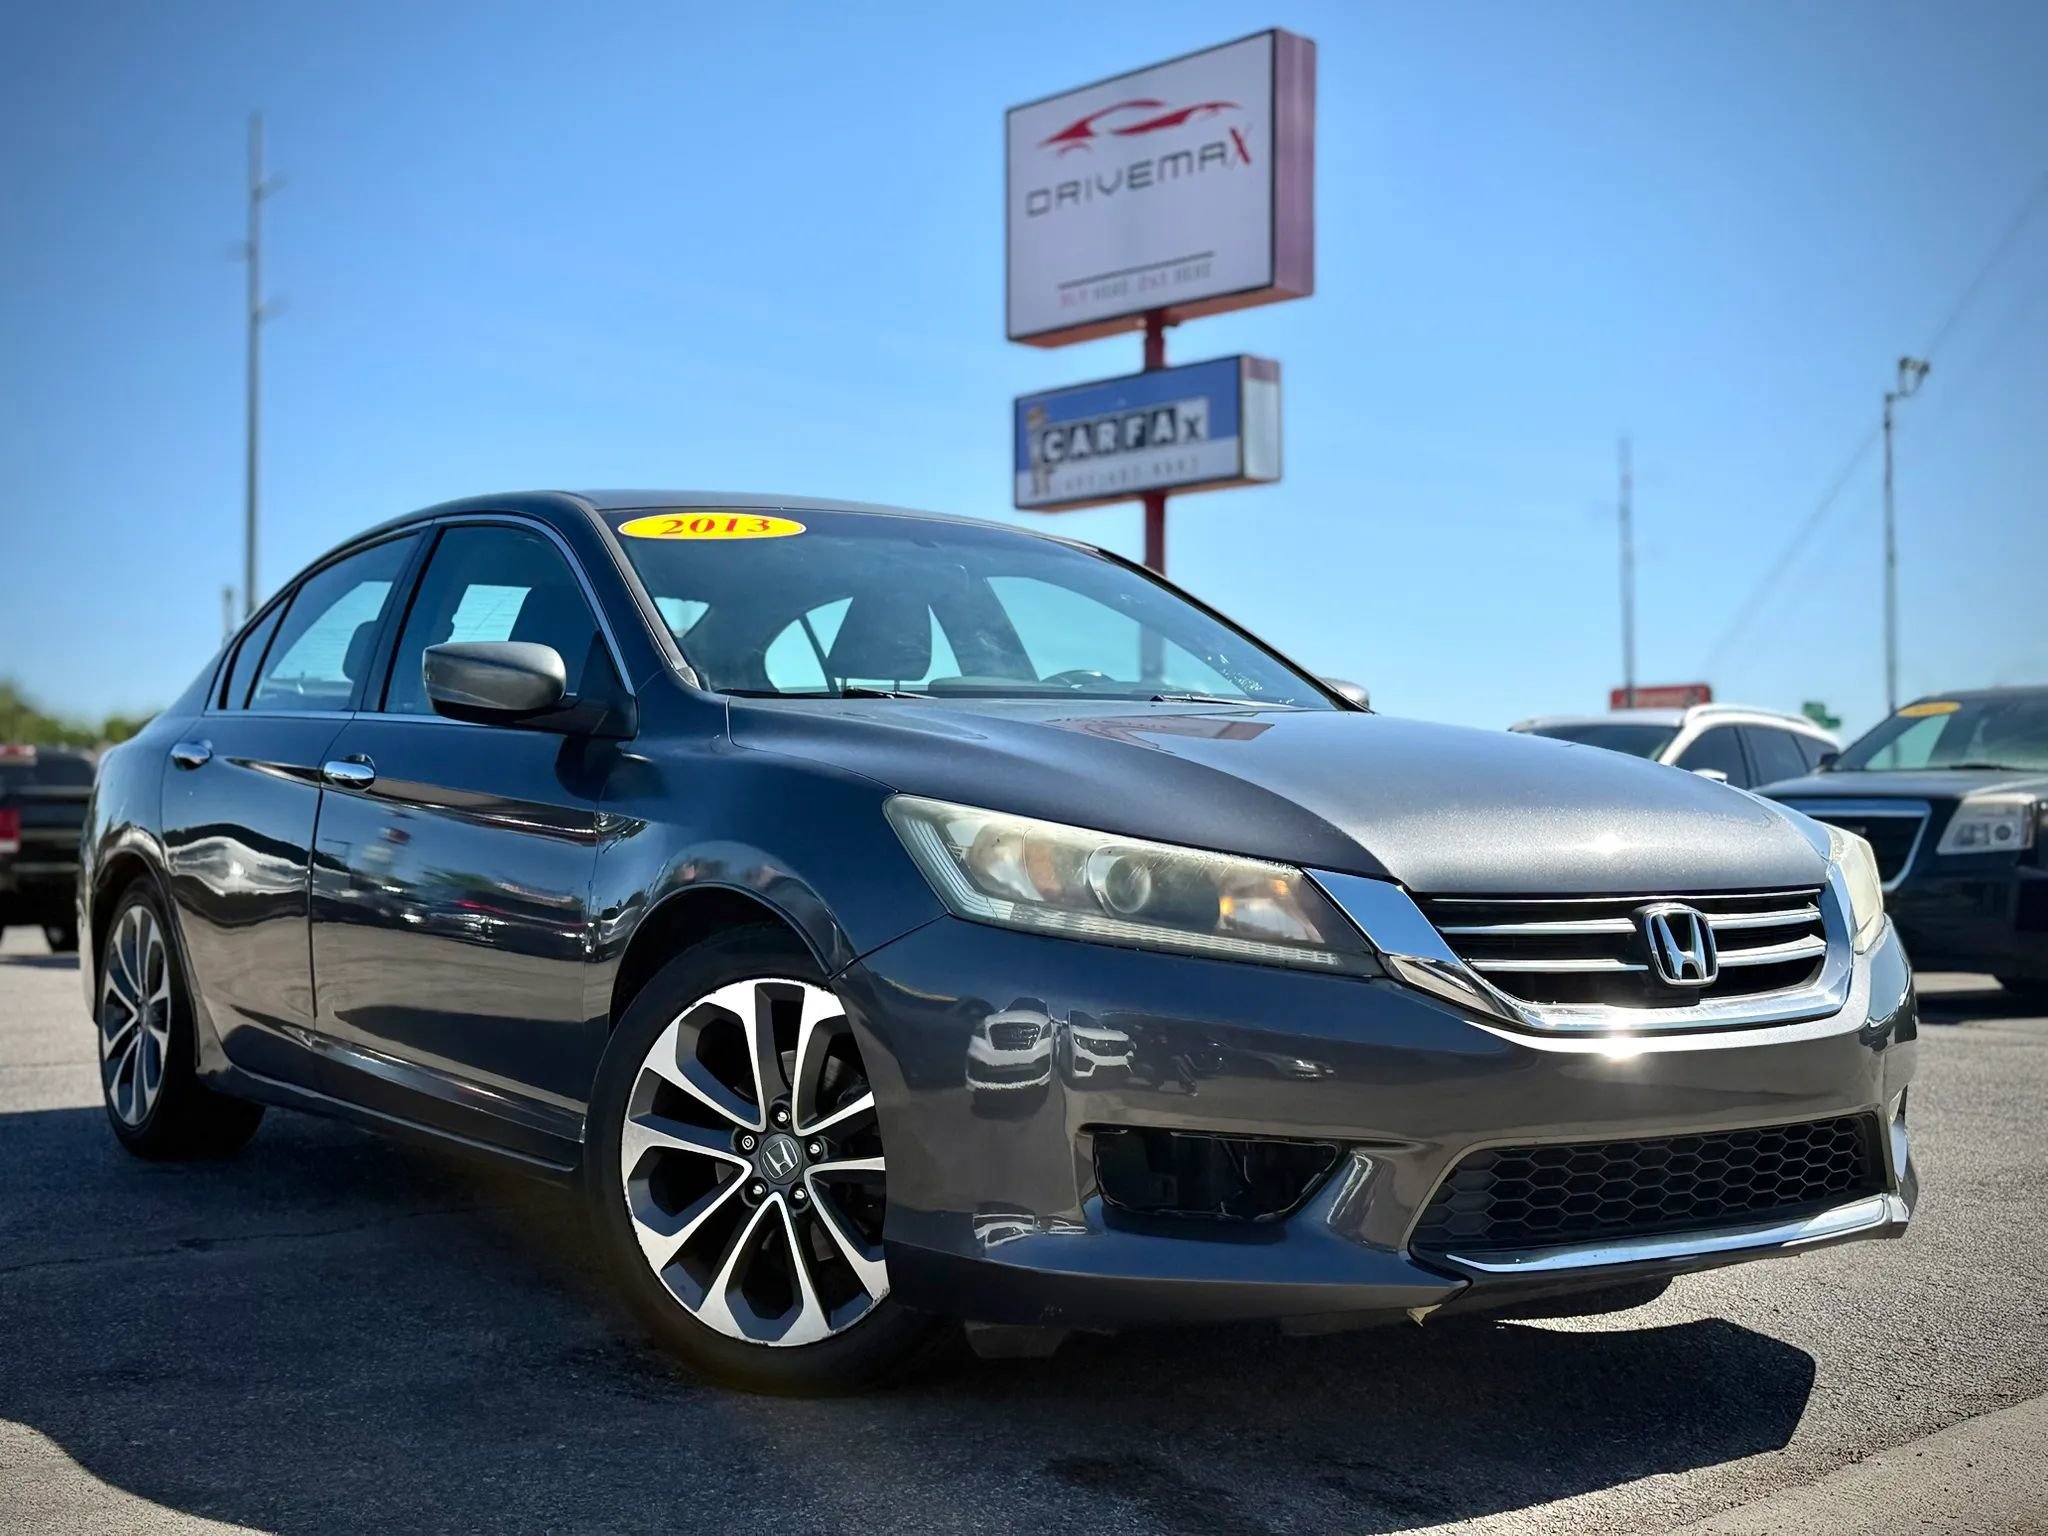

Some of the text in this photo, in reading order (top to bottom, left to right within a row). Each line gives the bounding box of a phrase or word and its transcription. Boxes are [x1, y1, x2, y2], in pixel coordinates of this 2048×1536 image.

[1025, 123, 1253, 217] DRIVEMAX
[1042, 408, 1203, 463] CARFAX
[661, 517, 771, 535] 2013
